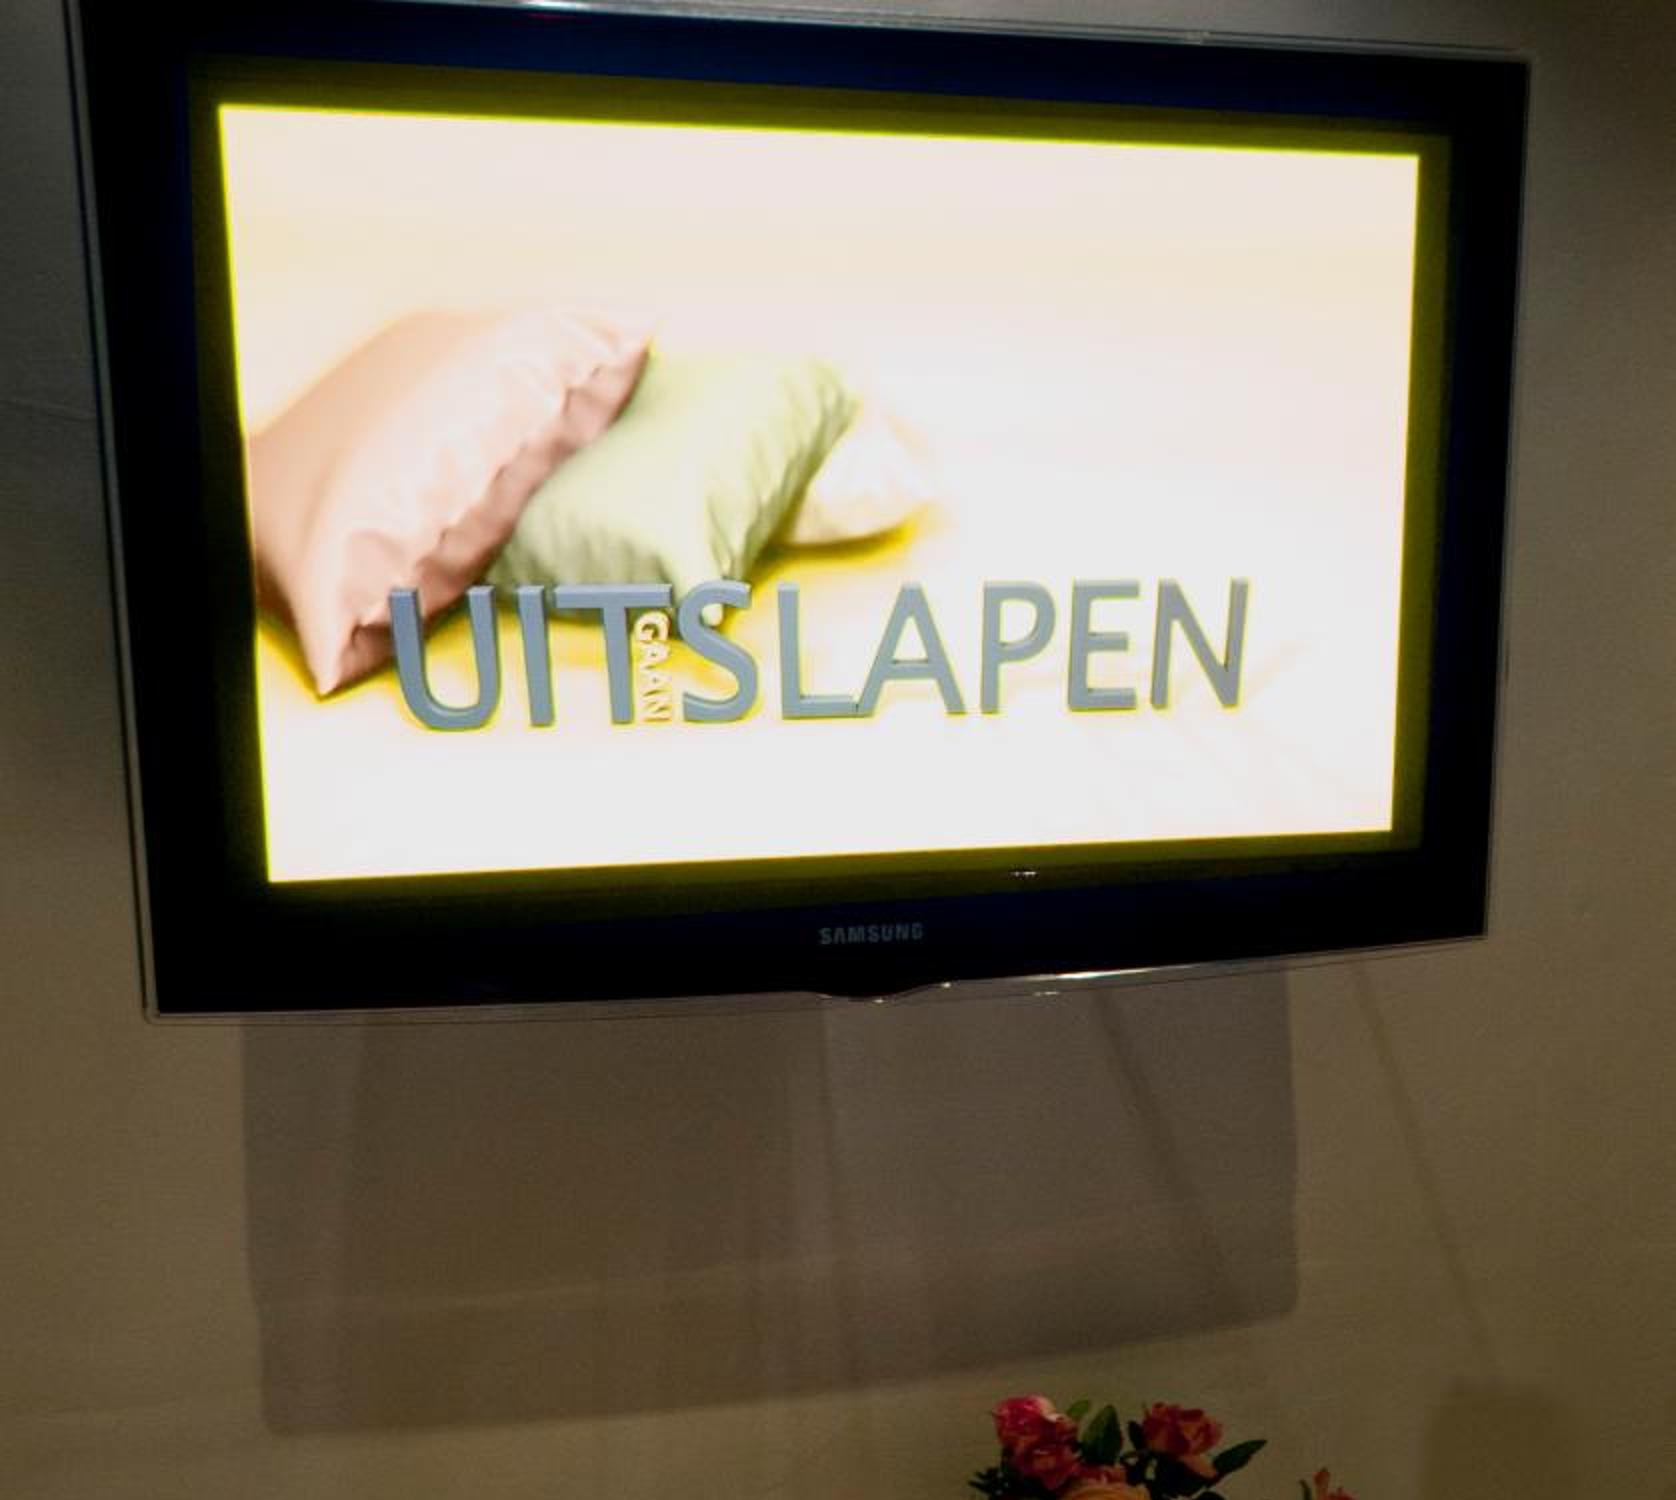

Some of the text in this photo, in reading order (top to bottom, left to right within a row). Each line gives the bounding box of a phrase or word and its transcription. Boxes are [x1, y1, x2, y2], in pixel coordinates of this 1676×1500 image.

[389, 579, 1249, 731] UITSLAPEN
[635, 611, 672, 723] GAAN
[818, 921, 924, 945] SAMSUNG
